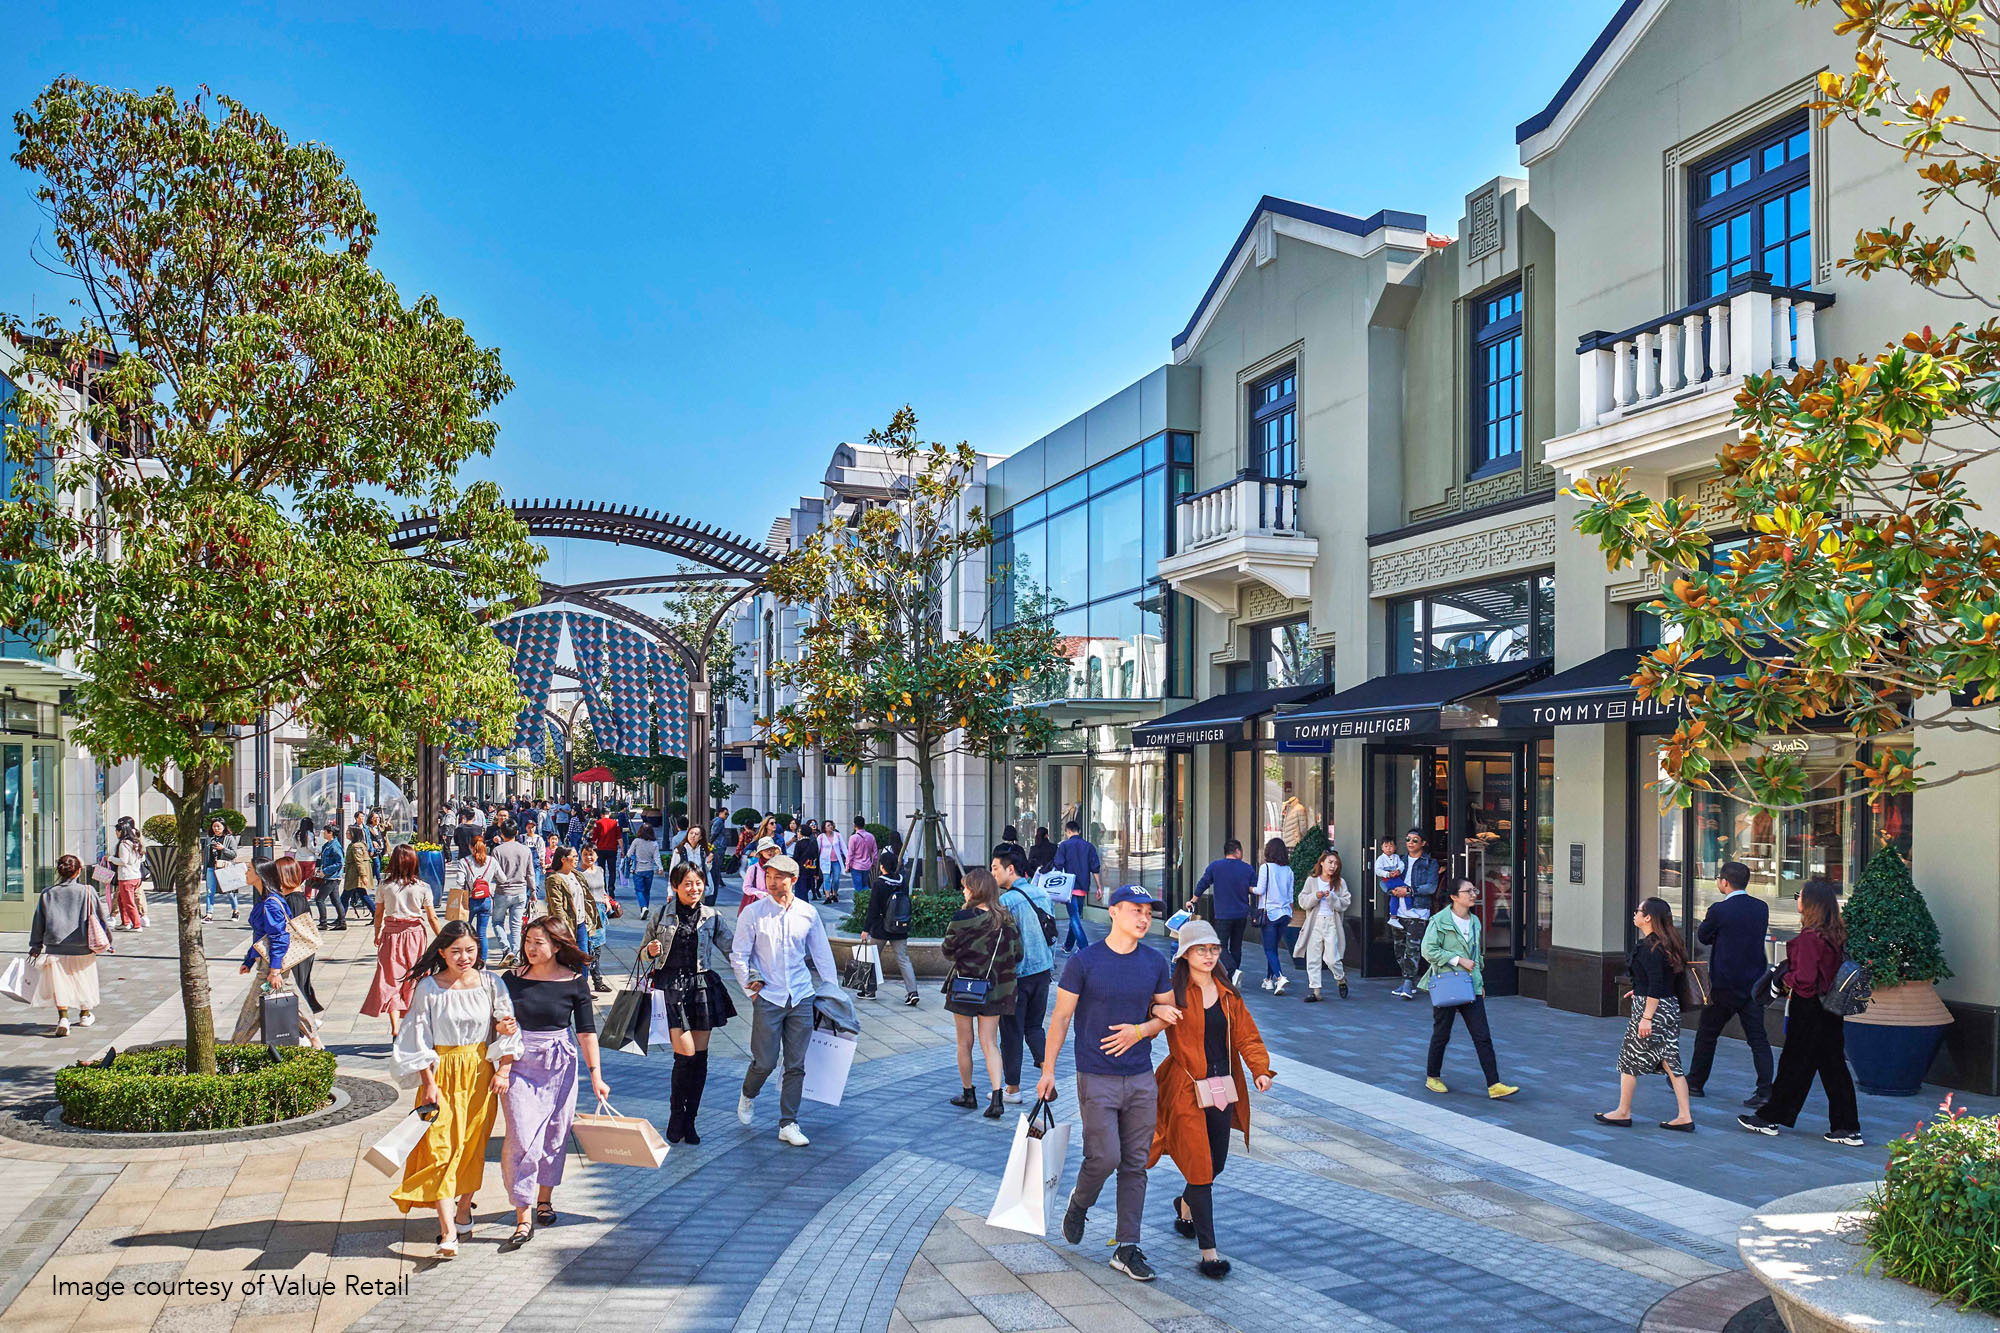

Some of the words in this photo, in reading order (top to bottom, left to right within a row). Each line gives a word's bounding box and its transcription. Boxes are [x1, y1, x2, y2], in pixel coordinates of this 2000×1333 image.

[1532, 703, 1603, 723] TOMMY
[1632, 695, 1710, 716] HILFI
[1295, 723, 1339, 738] TOMMY
[1354, 717, 1410, 735] HILFIGER
[1146, 733, 1176, 745] TOMMY
[1186, 729, 1224, 742] HILFIGER
[812, 1038, 839, 1049] andro
